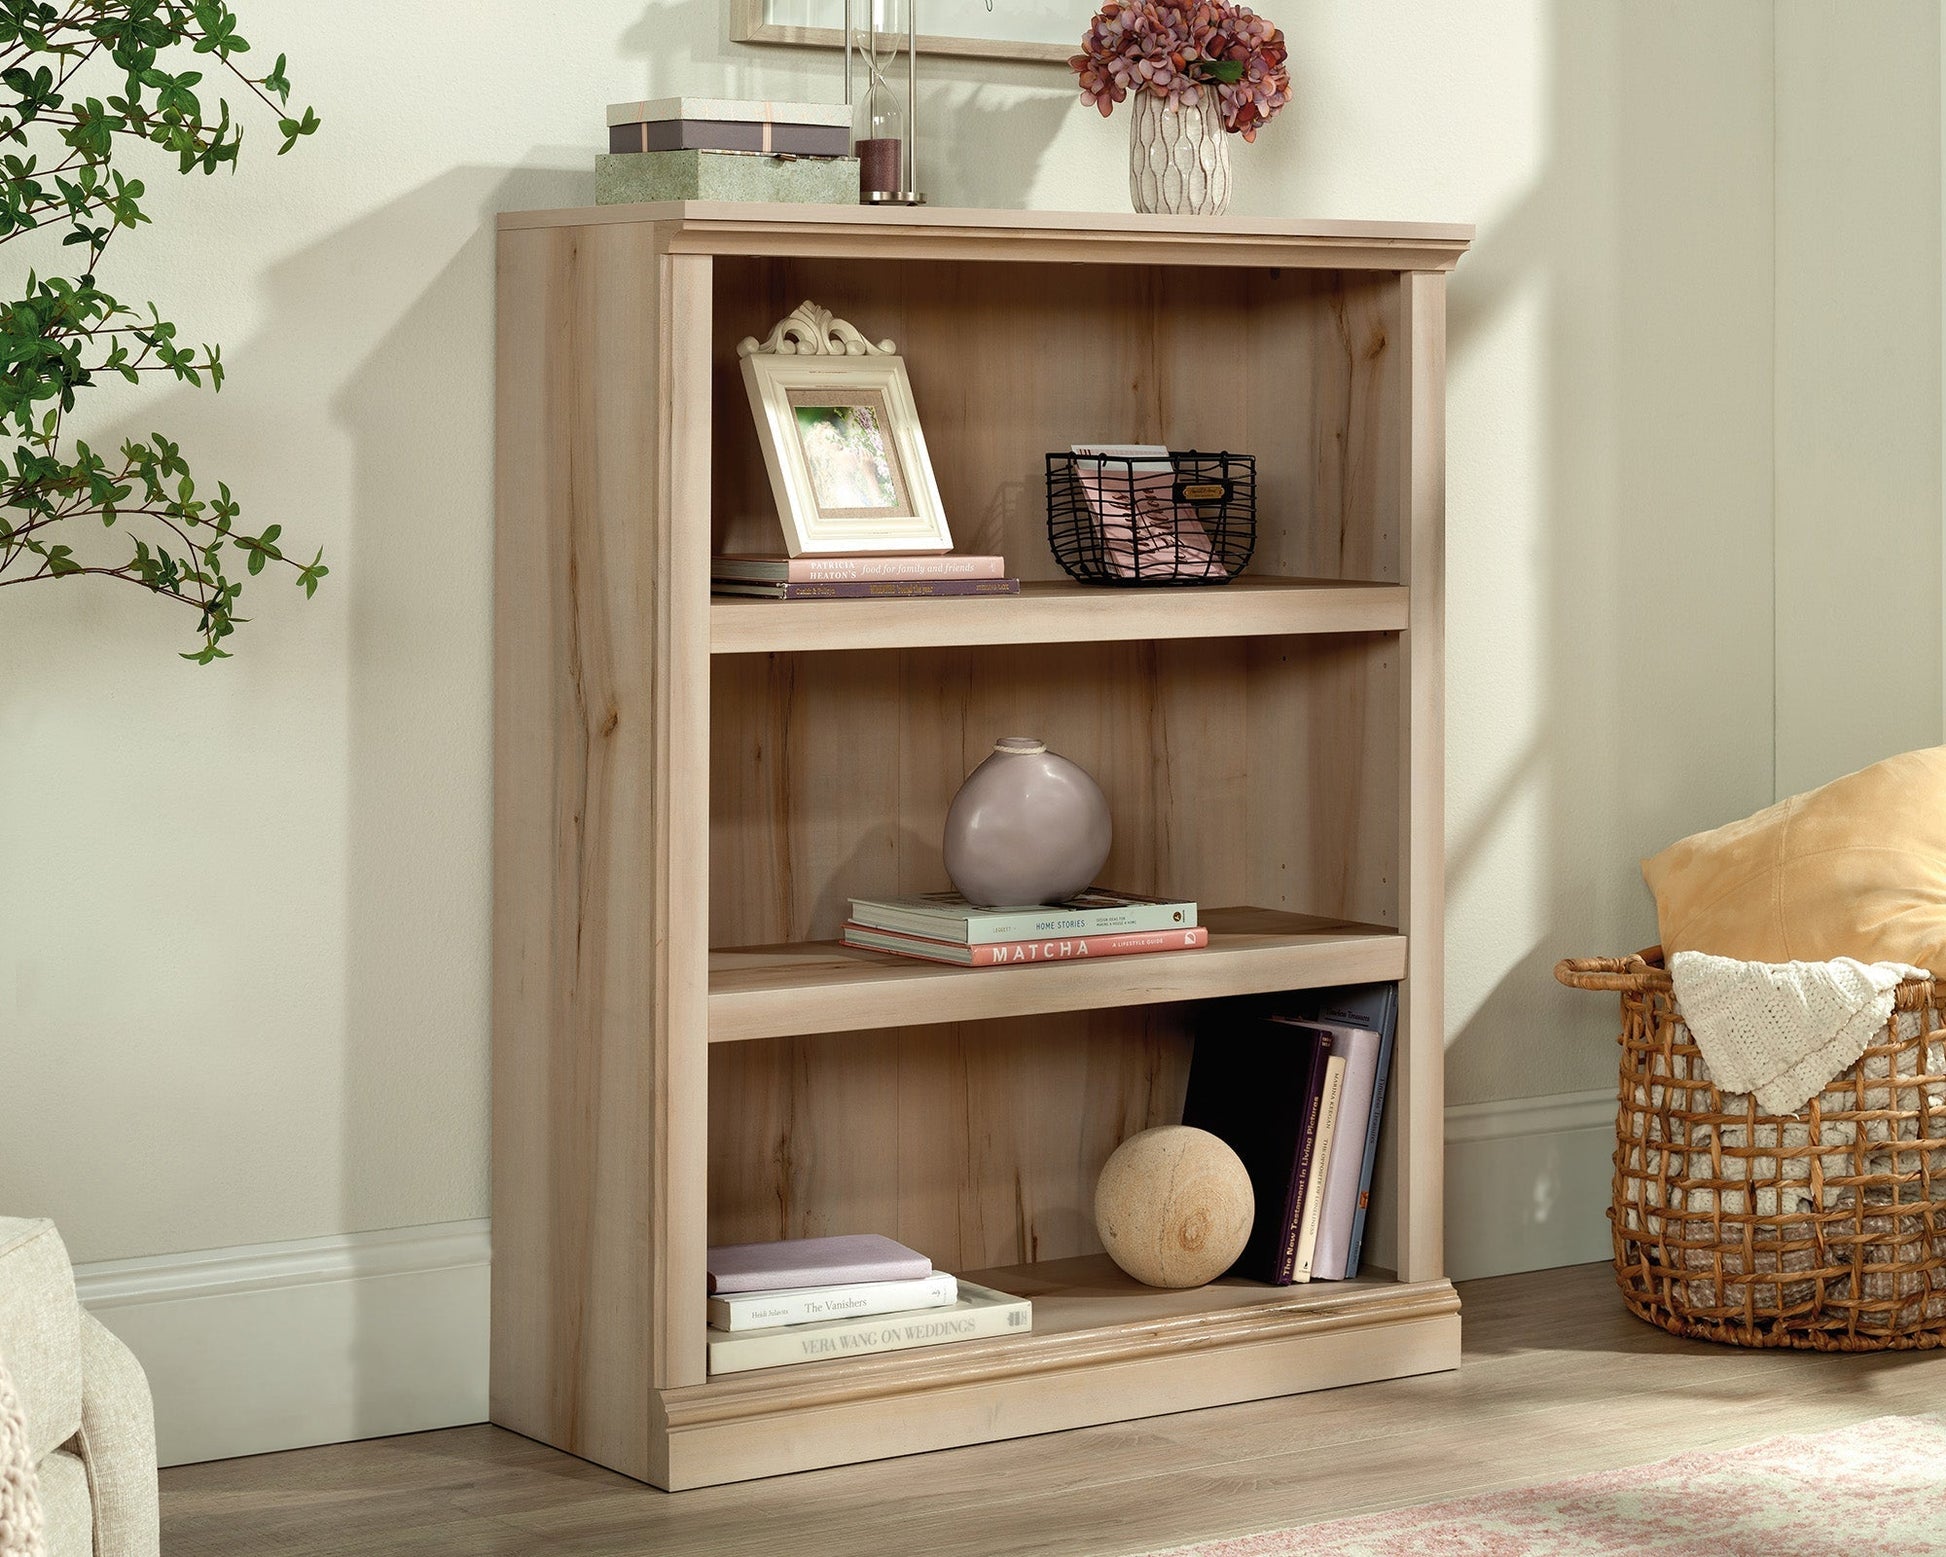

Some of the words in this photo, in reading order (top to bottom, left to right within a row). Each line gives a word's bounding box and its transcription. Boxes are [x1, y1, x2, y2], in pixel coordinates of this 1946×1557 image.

[810, 561, 855, 570] PATRICIA
[861, 565, 881, 575] food
[882, 564, 896, 575] for
[897, 564, 925, 575] family
[927, 563, 942, 573] and
[942, 563, 975, 574] friends
[1036, 921, 1055, 930] HOME
[1057, 919, 1086, 929] STORIES
[992, 940, 1088, 962] MATCHA
[1330, 1073, 1340, 1100] MARINA
[1306, 1096, 1319, 1135] Pictures
[1301, 1137, 1312, 1166] Living
[1290, 1180, 1305, 1230] Testament
[1287, 1233, 1296, 1256] New
[1283, 1258, 1292, 1276] The
[804, 1302, 823, 1313] The
[825, 1298, 868, 1311] Vanishers
[801, 1337, 837, 1354] VERA
[839, 1332, 877, 1350] WANG
[881, 1329, 902, 1344] ON
[904, 1318, 976, 1341] WEDDINGS
